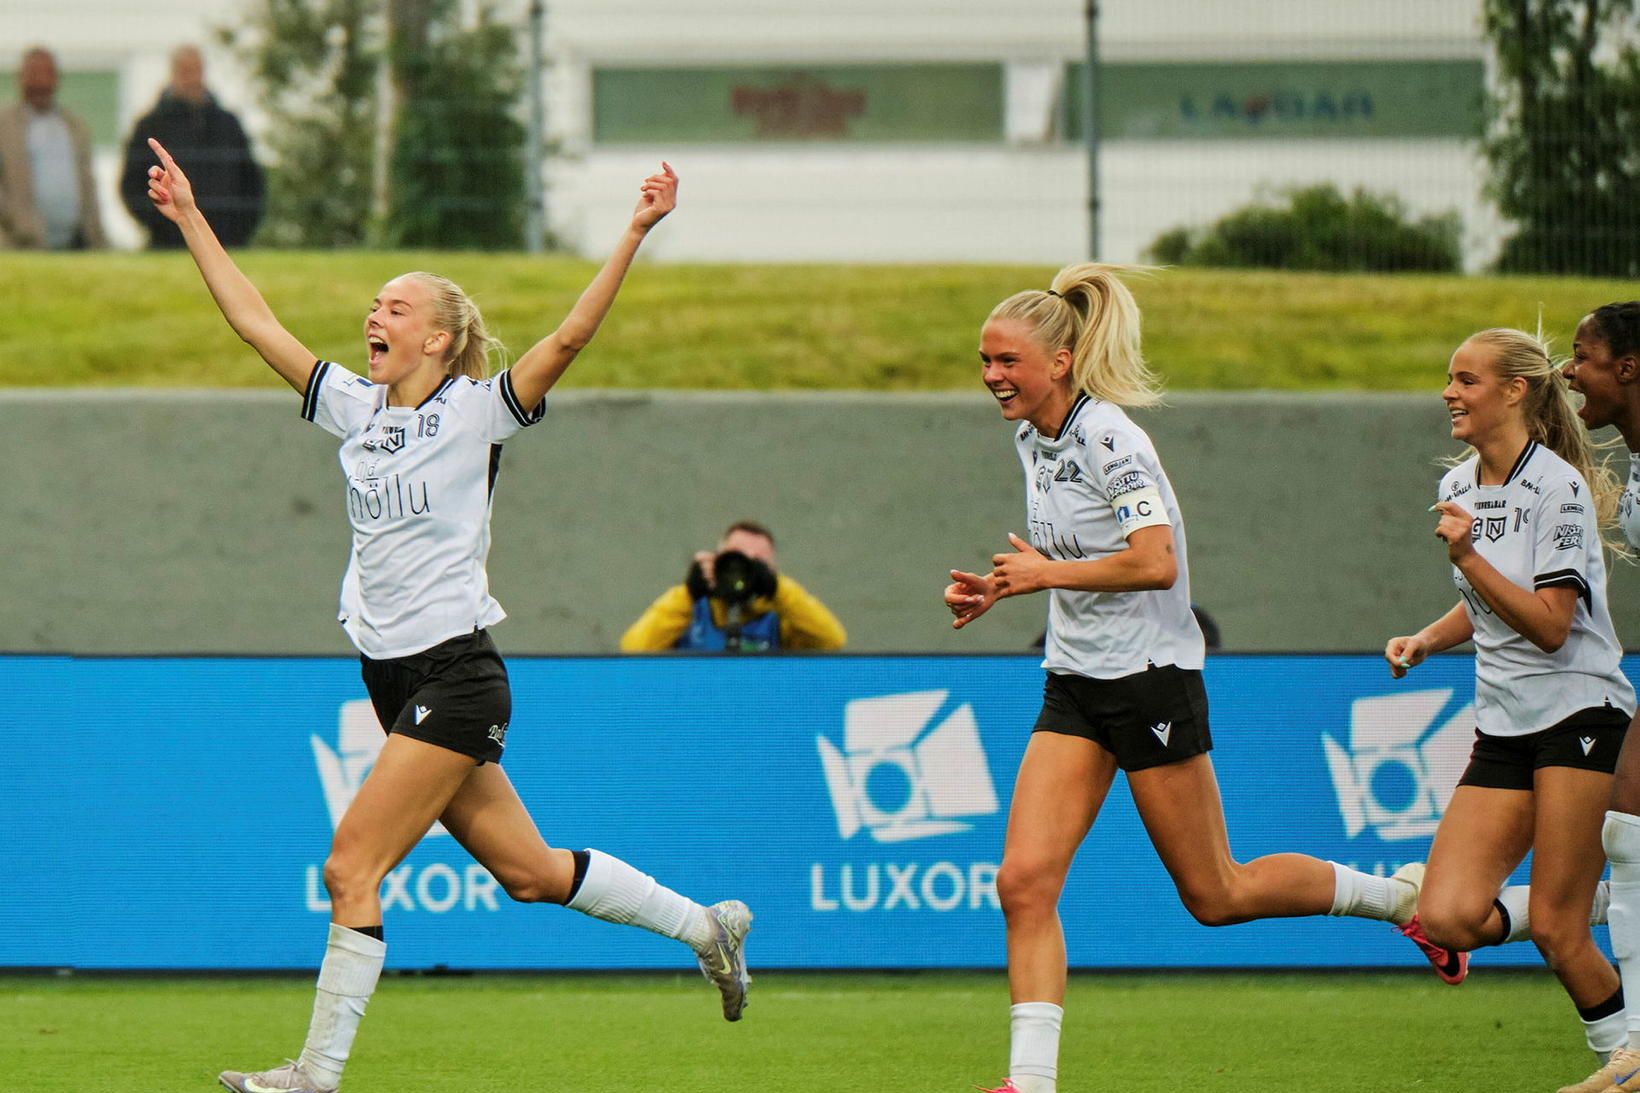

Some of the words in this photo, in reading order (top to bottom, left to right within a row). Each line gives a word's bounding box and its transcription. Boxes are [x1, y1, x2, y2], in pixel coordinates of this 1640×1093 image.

[418, 413, 440, 438] 18
[1054, 458, 1083, 483] 22
[1137, 500, 1152, 517] C
[305, 863, 500, 912] LXOR
[811, 862, 1002, 912] LUXOR
